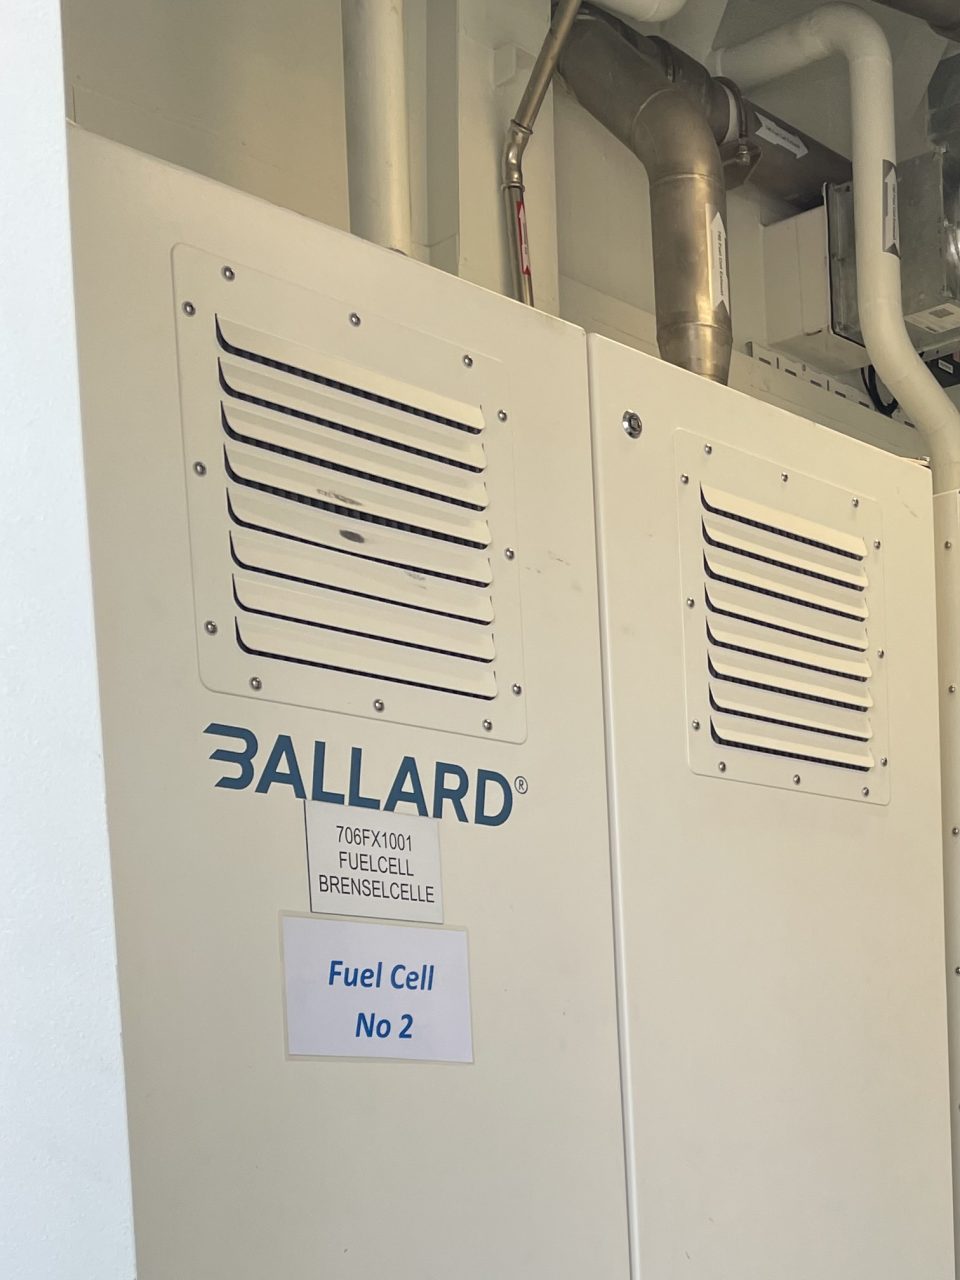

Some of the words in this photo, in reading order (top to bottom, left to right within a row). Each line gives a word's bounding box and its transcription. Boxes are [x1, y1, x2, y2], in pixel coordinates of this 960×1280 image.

[335, 825, 412, 852] 706FX1001
[338, 851, 415, 877] FUELCELL
[318, 875, 436, 904] BRENSELCELLE
[328, 960, 383, 989] Fuel
[389, 963, 435, 991] Cell
[354, 1012, 392, 1039] No
[398, 1013, 414, 1039] 2
